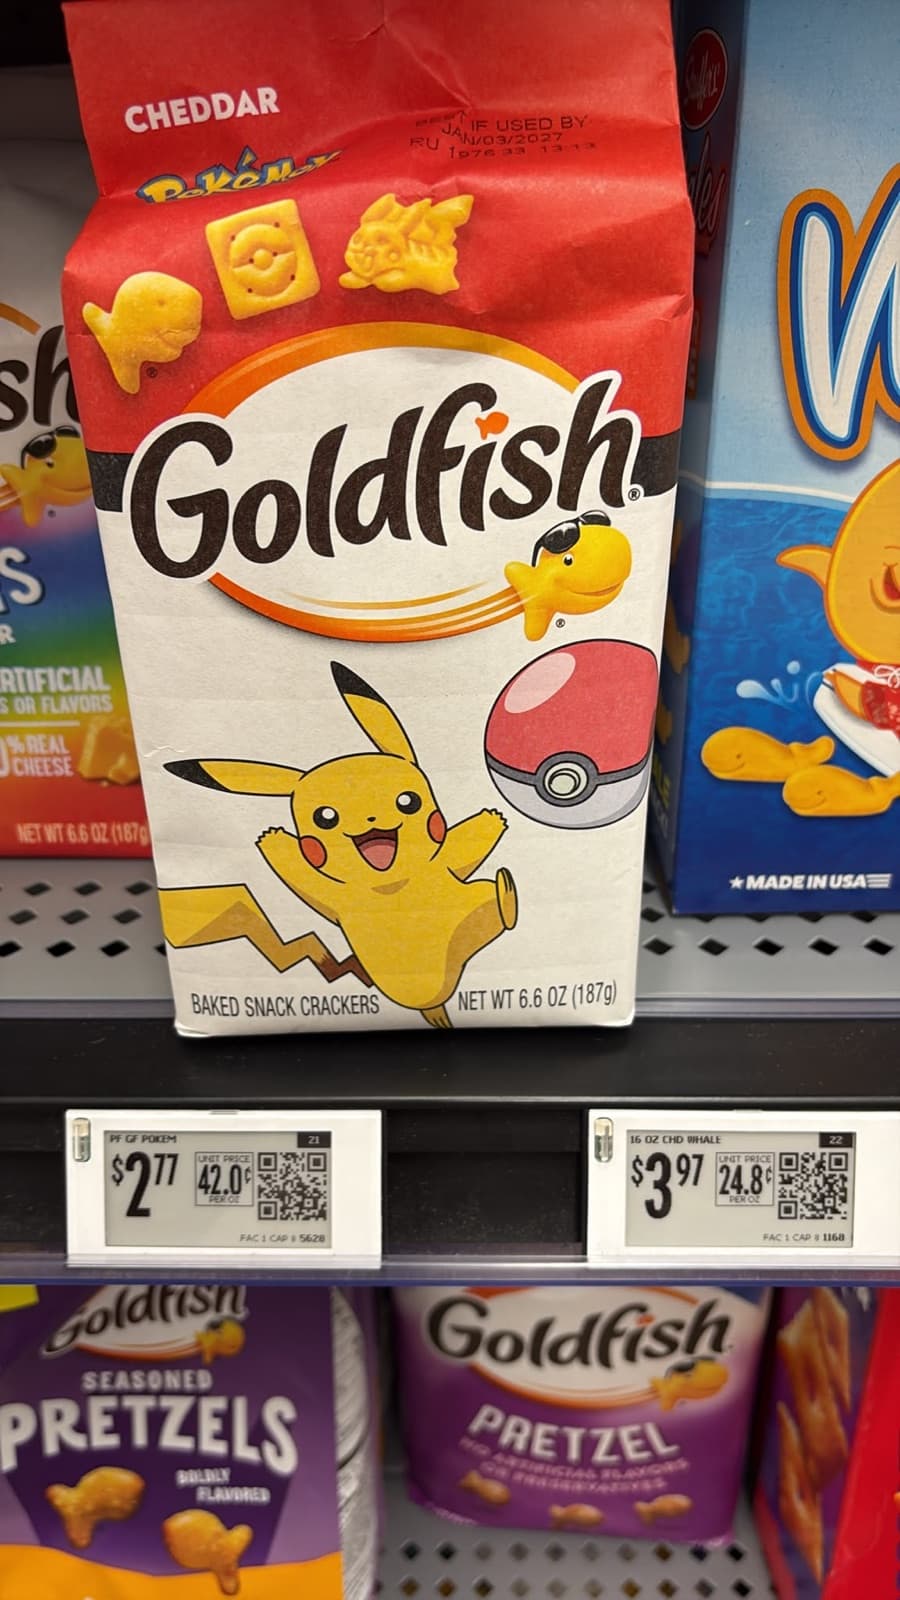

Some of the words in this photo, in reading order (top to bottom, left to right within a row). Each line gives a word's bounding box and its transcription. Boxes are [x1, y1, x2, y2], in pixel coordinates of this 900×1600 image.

[124, 86, 280, 133] CHEDDAR
[471, 120, 488, 132] IF
[496, 118, 552, 131] USED
[560, 115, 589, 129] BY
[441, 123, 562, 147] JAN/03/2027
[409, 137, 439, 151] RU
[130, 377, 628, 579] Goldfish
[0, 666, 111, 693] RTIFICIAL
[13, 696, 37, 715] OR
[42, 694, 113, 714] FLAVORS
[25, 735, 69, 755] REAL
[12, 756, 74, 777] CHEESE
[17, 823, 41, 843] NET
[44, 823, 64, 843] WT
[66, 823, 89, 843] 6.6
[91, 822, 109, 843] OZ
[111, 821, 150, 846] (187g
[745, 875, 803, 890] MADE
[806, 875, 827, 889] IN
[829, 874, 867, 888] USA
[458, 990, 486, 1011] NET
[490, 989, 514, 1010] WT
[519, 987, 542, 1009] 6.6
[546, 985, 568, 1008] OZ
[570, 980, 617, 1010] (187g)
[191, 993, 240, 1017] BAKED
[244, 996, 296, 1017] SNACK
[300, 994, 380, 1017] CRACKERS
[110, 1134, 123, 1143] PF
[125, 1134, 139, 1143] GF
[141, 1134, 177, 1143] POKEM
[308, 1135, 320, 1143] 21
[630, 1135, 641, 1144] 16
[645, 1135, 659, 1144] OZ
[662, 1135, 683, 1144] CHD
[687, 1136, 721, 1144] WHALE
[829, 1136, 843, 1144] 22
[198, 1155, 220, 1163] UNIT
[223, 1155, 250, 1163] PRICE
[719, 1155, 741, 1163] UNIT
[745, 1155, 772, 1163] PRICE
[208, 1195, 225, 1203] PER
[729, 1195, 746, 1203] PER
[748, 1195, 760, 1203] OZ
[240, 1235, 260, 1243] FAC
[269, 1235, 288, 1243] CAP
[763, 1233, 782, 1241] FAC
[792, 1233, 811, 1241] CAP
[428, 1297, 731, 1370] Goldfish
[83, 1369, 213, 1391] SEASONED
[0, 1396, 298, 1475] PRETZELS
[468, 1404, 680, 1466] PRETZEL
[176, 1468, 231, 1485] BOLDLY
[197, 1486, 271, 1503] FLAVORED
